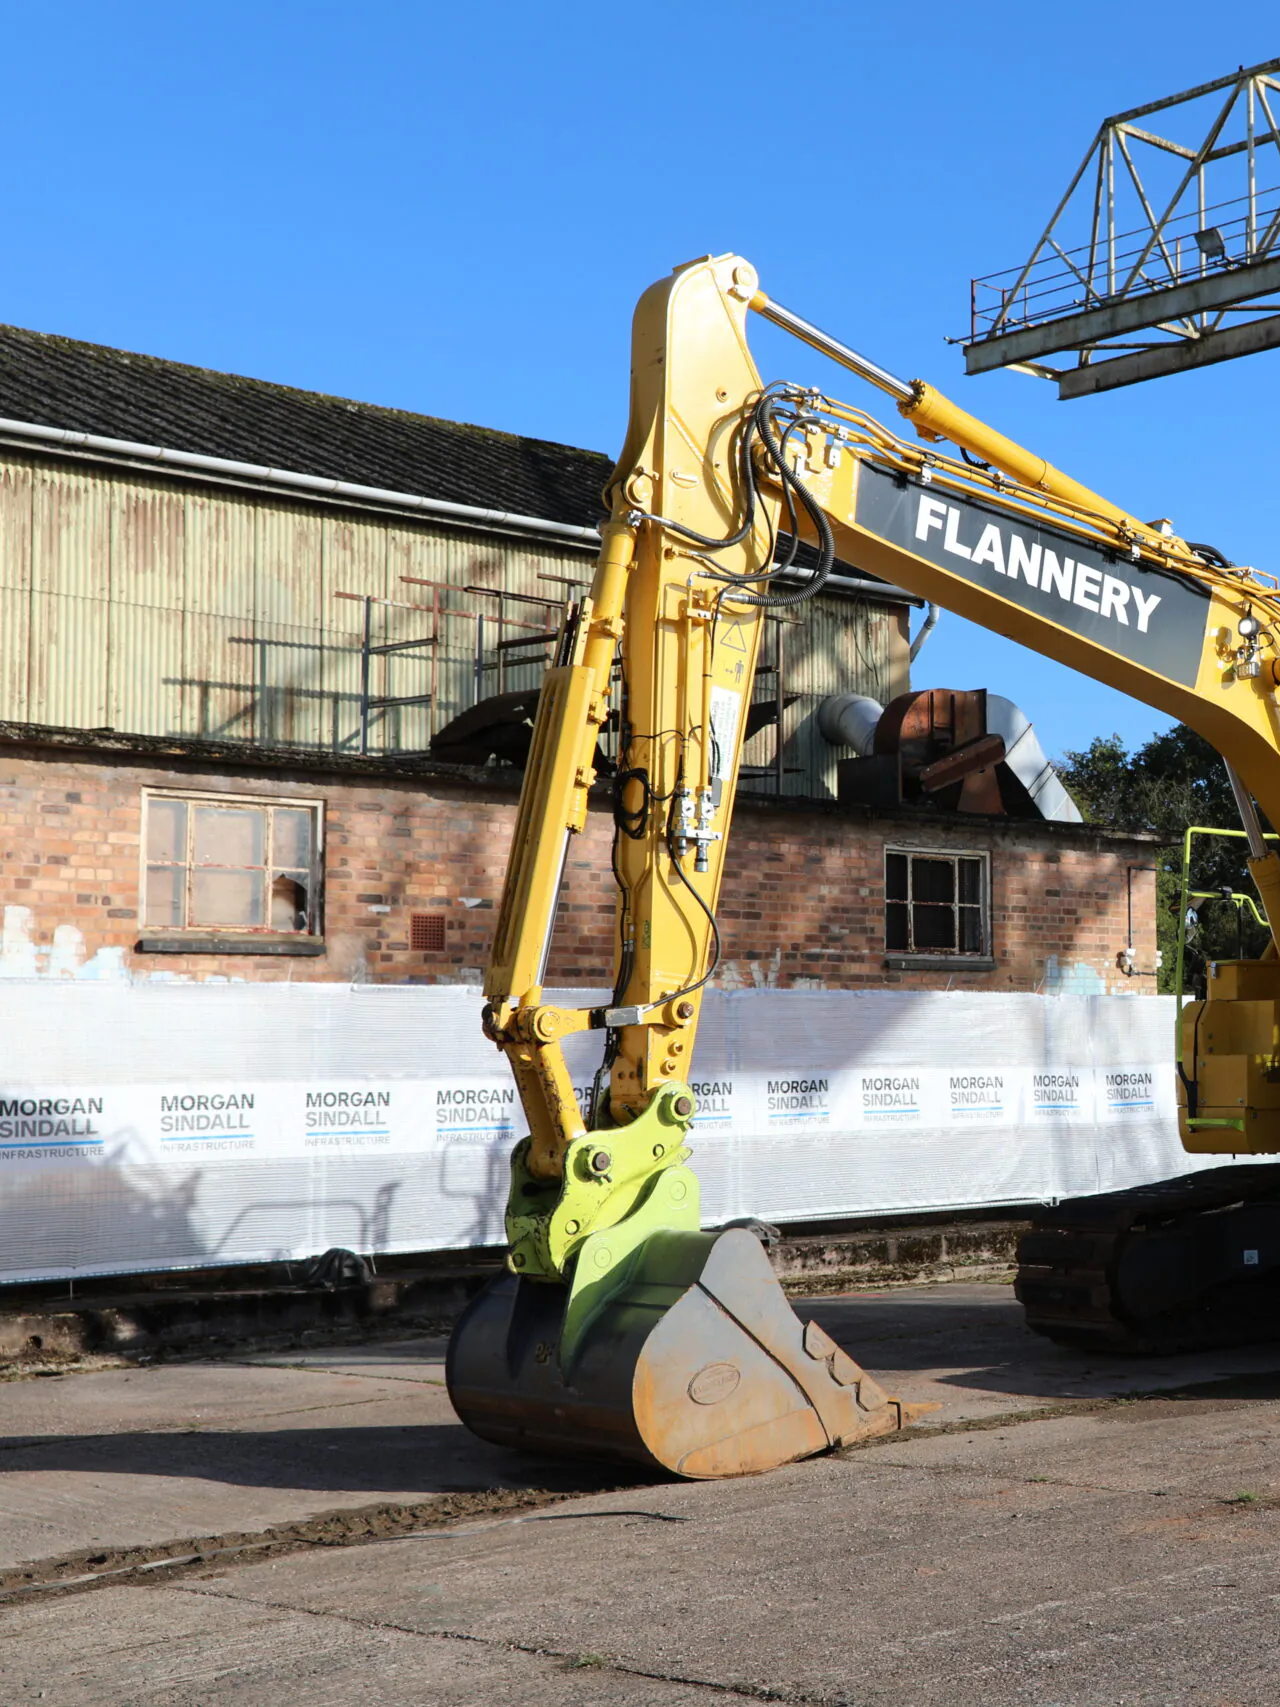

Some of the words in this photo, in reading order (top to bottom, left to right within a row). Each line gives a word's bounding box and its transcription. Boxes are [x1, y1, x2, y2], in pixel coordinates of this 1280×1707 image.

[915, 494, 1162, 633] FLANNERY
[767, 1079, 828, 1094] MORGAN
[862, 1077, 920, 1091] MORGAN
[950, 1076, 1003, 1089] MORGAN
[1033, 1075, 1079, 1088] MORGAN
[1106, 1073, 1152, 1086] MORGAN
[691, 1082, 732, 1096] RGAN
[1034, 1089, 1078, 1102] SINDALL
[1107, 1087, 1151, 1100] SINDALL
[161, 1093, 254, 1112] MORGAN
[306, 1091, 390, 1108] MORGAN
[436, 1089, 514, 1105] MORGAN
[768, 1095, 828, 1110] SINDALL
[862, 1093, 917, 1107] SINDALL
[951, 1091, 1001, 1104] SINDALL
[0, 1097, 103, 1117] MORGAN
[695, 1098, 730, 1112] DALL
[305, 1110, 386, 1127] SINDALL
[436, 1107, 511, 1123] SINDALL
[0, 1118, 99, 1138] SINDALL
[160, 1113, 251, 1132] SINDALL
[161, 1140, 256, 1152] INFRASTRUCTURE
[304, 1136, 391, 1147] INFRASTRUCTURE
